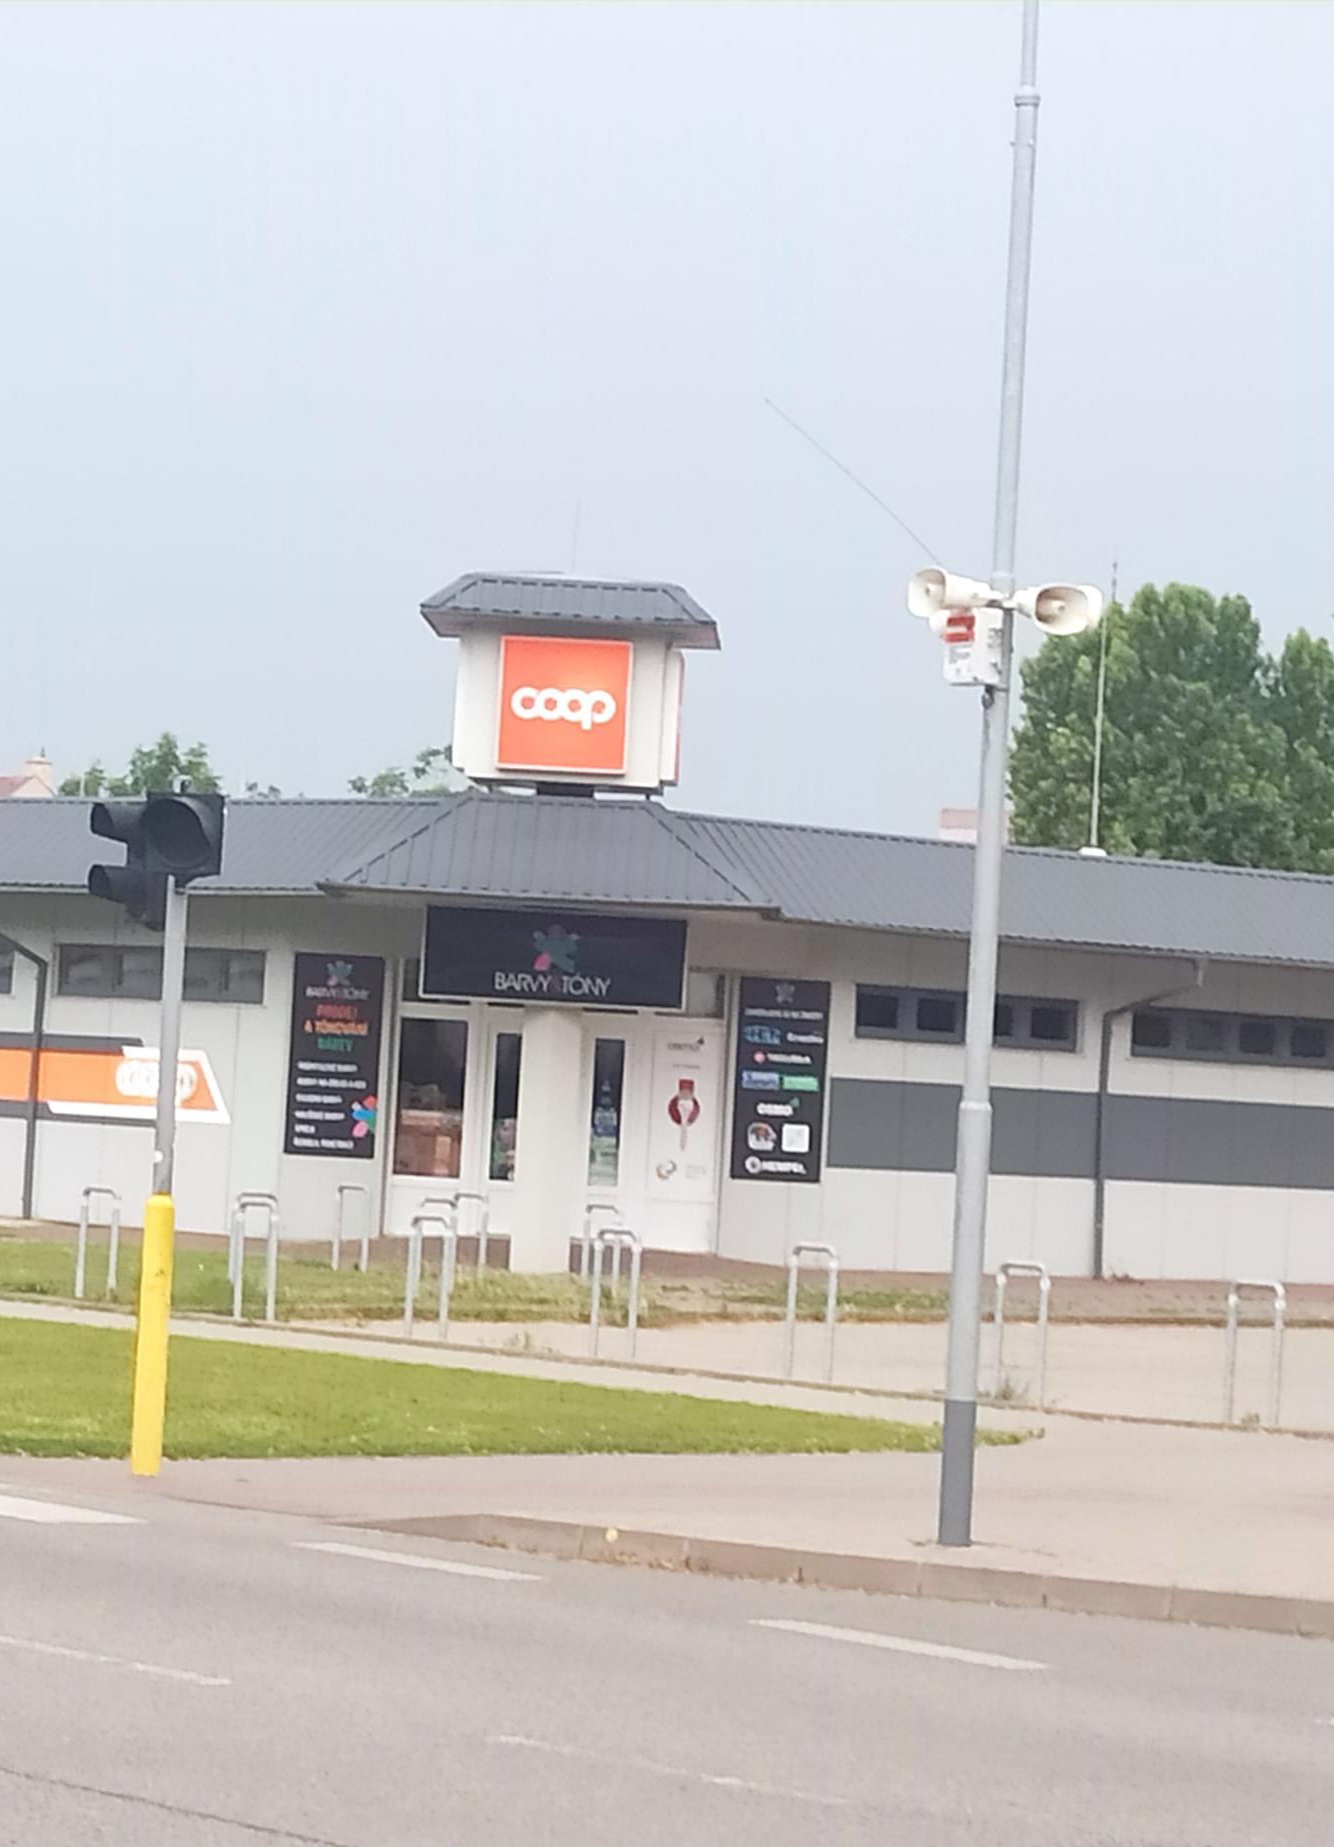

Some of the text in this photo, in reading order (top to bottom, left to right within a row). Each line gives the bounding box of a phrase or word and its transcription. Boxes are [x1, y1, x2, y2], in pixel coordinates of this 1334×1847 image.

[511, 686, 616, 730] coop
[494, 971, 550, 992] BARVY
[562, 971, 611, 996] TÓNY
